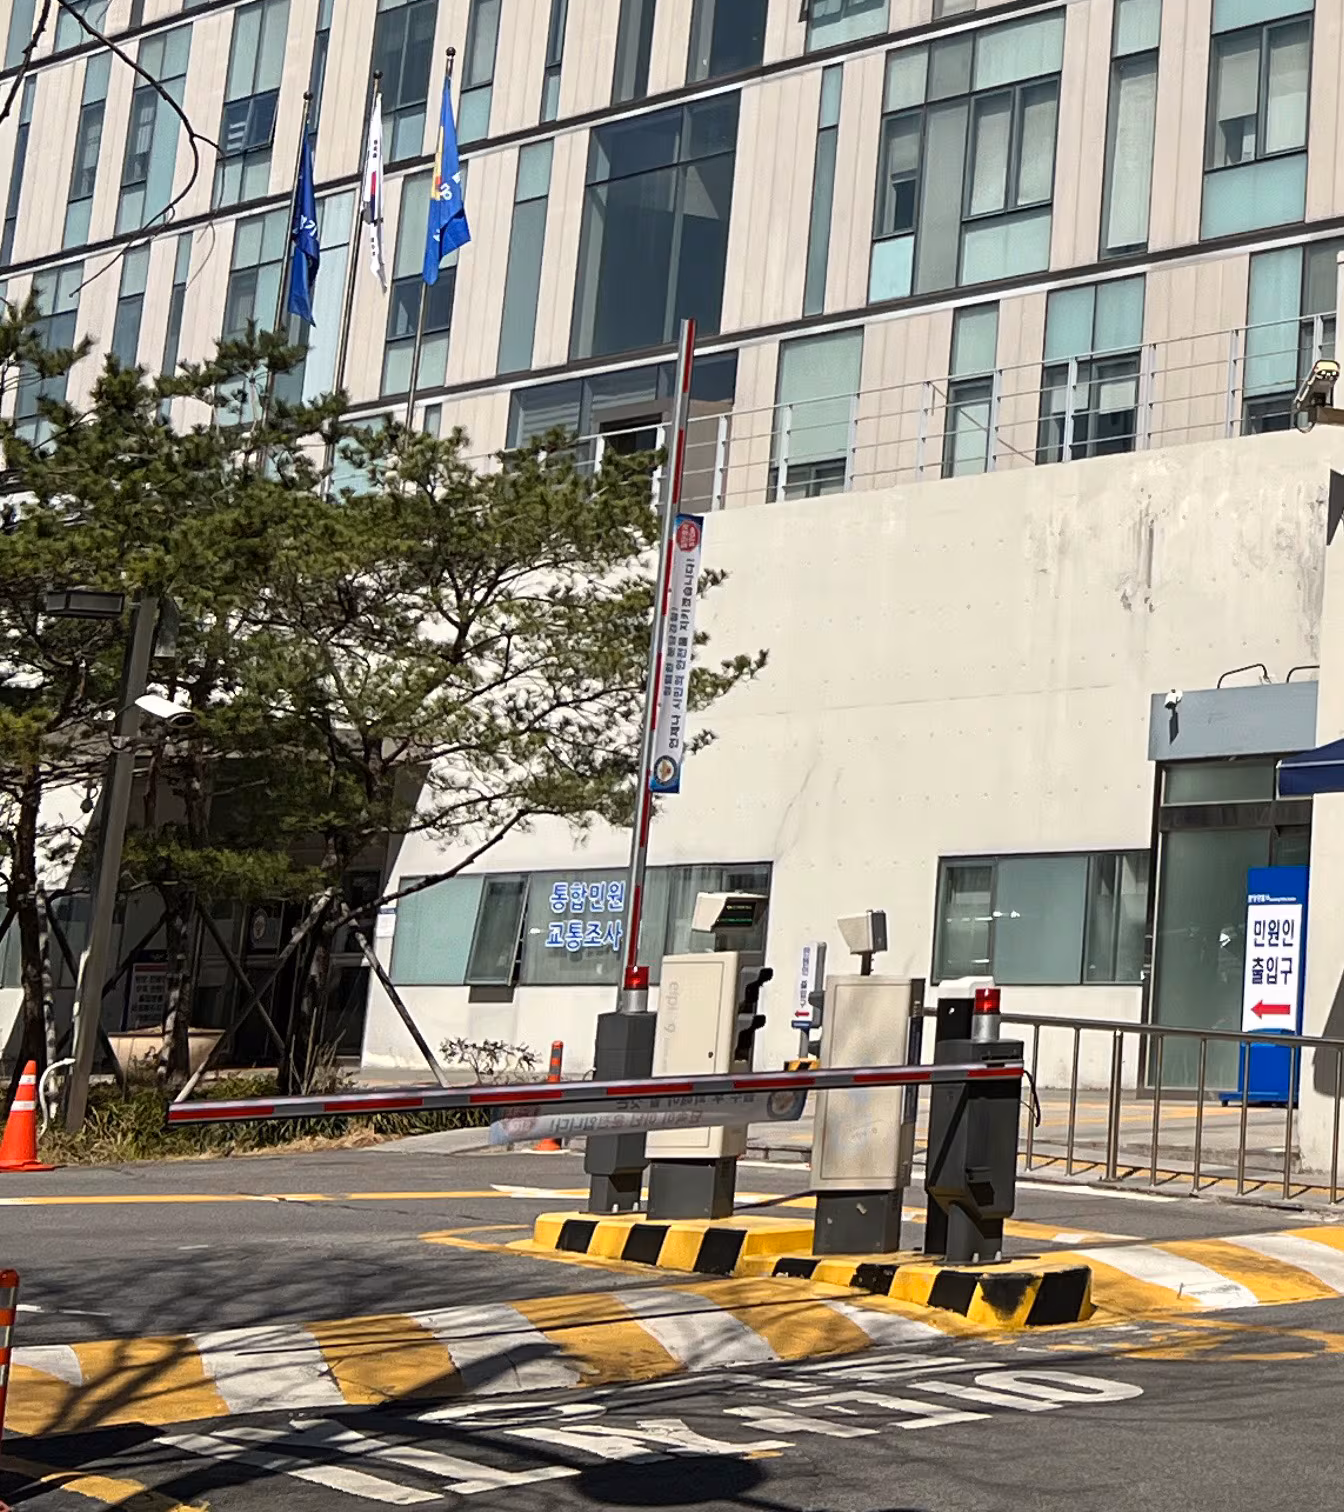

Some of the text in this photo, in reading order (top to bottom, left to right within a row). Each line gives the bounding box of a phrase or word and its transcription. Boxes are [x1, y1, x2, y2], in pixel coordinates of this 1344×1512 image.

[549, 880, 626, 913] 통합민원
[545, 919, 623, 952] 교통조사
[1253, 919, 1295, 947] 민원인
[1251, 956, 1293, 985] 출입구
